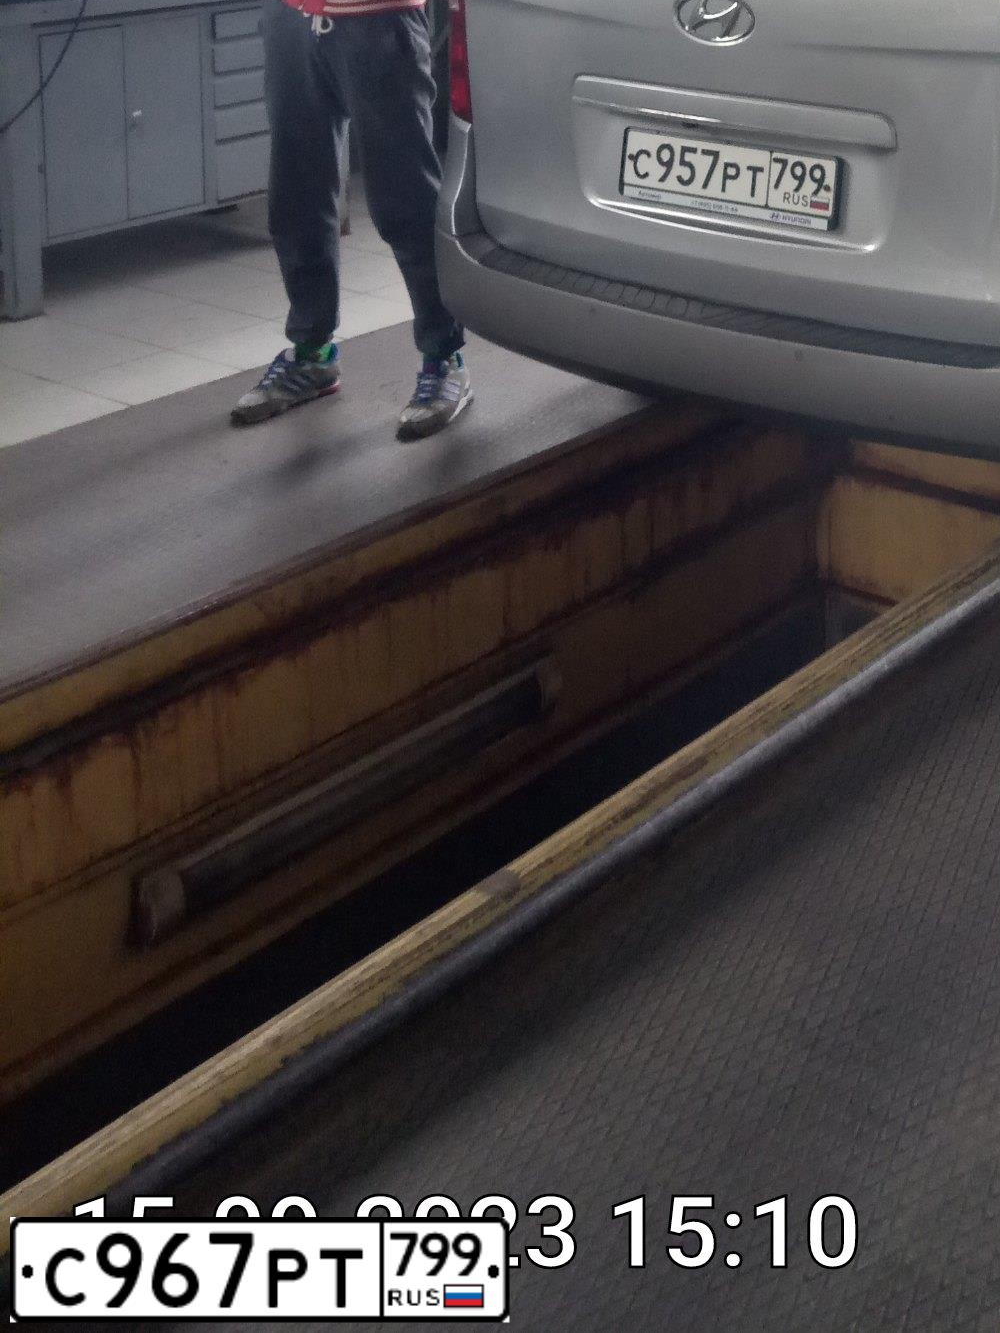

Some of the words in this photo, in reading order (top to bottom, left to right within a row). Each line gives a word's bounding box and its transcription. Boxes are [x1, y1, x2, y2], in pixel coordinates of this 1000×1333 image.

[633, 143, 764, 198] C957PT
[772, 157, 826, 197] 799
[782, 192, 809, 208] RUS
